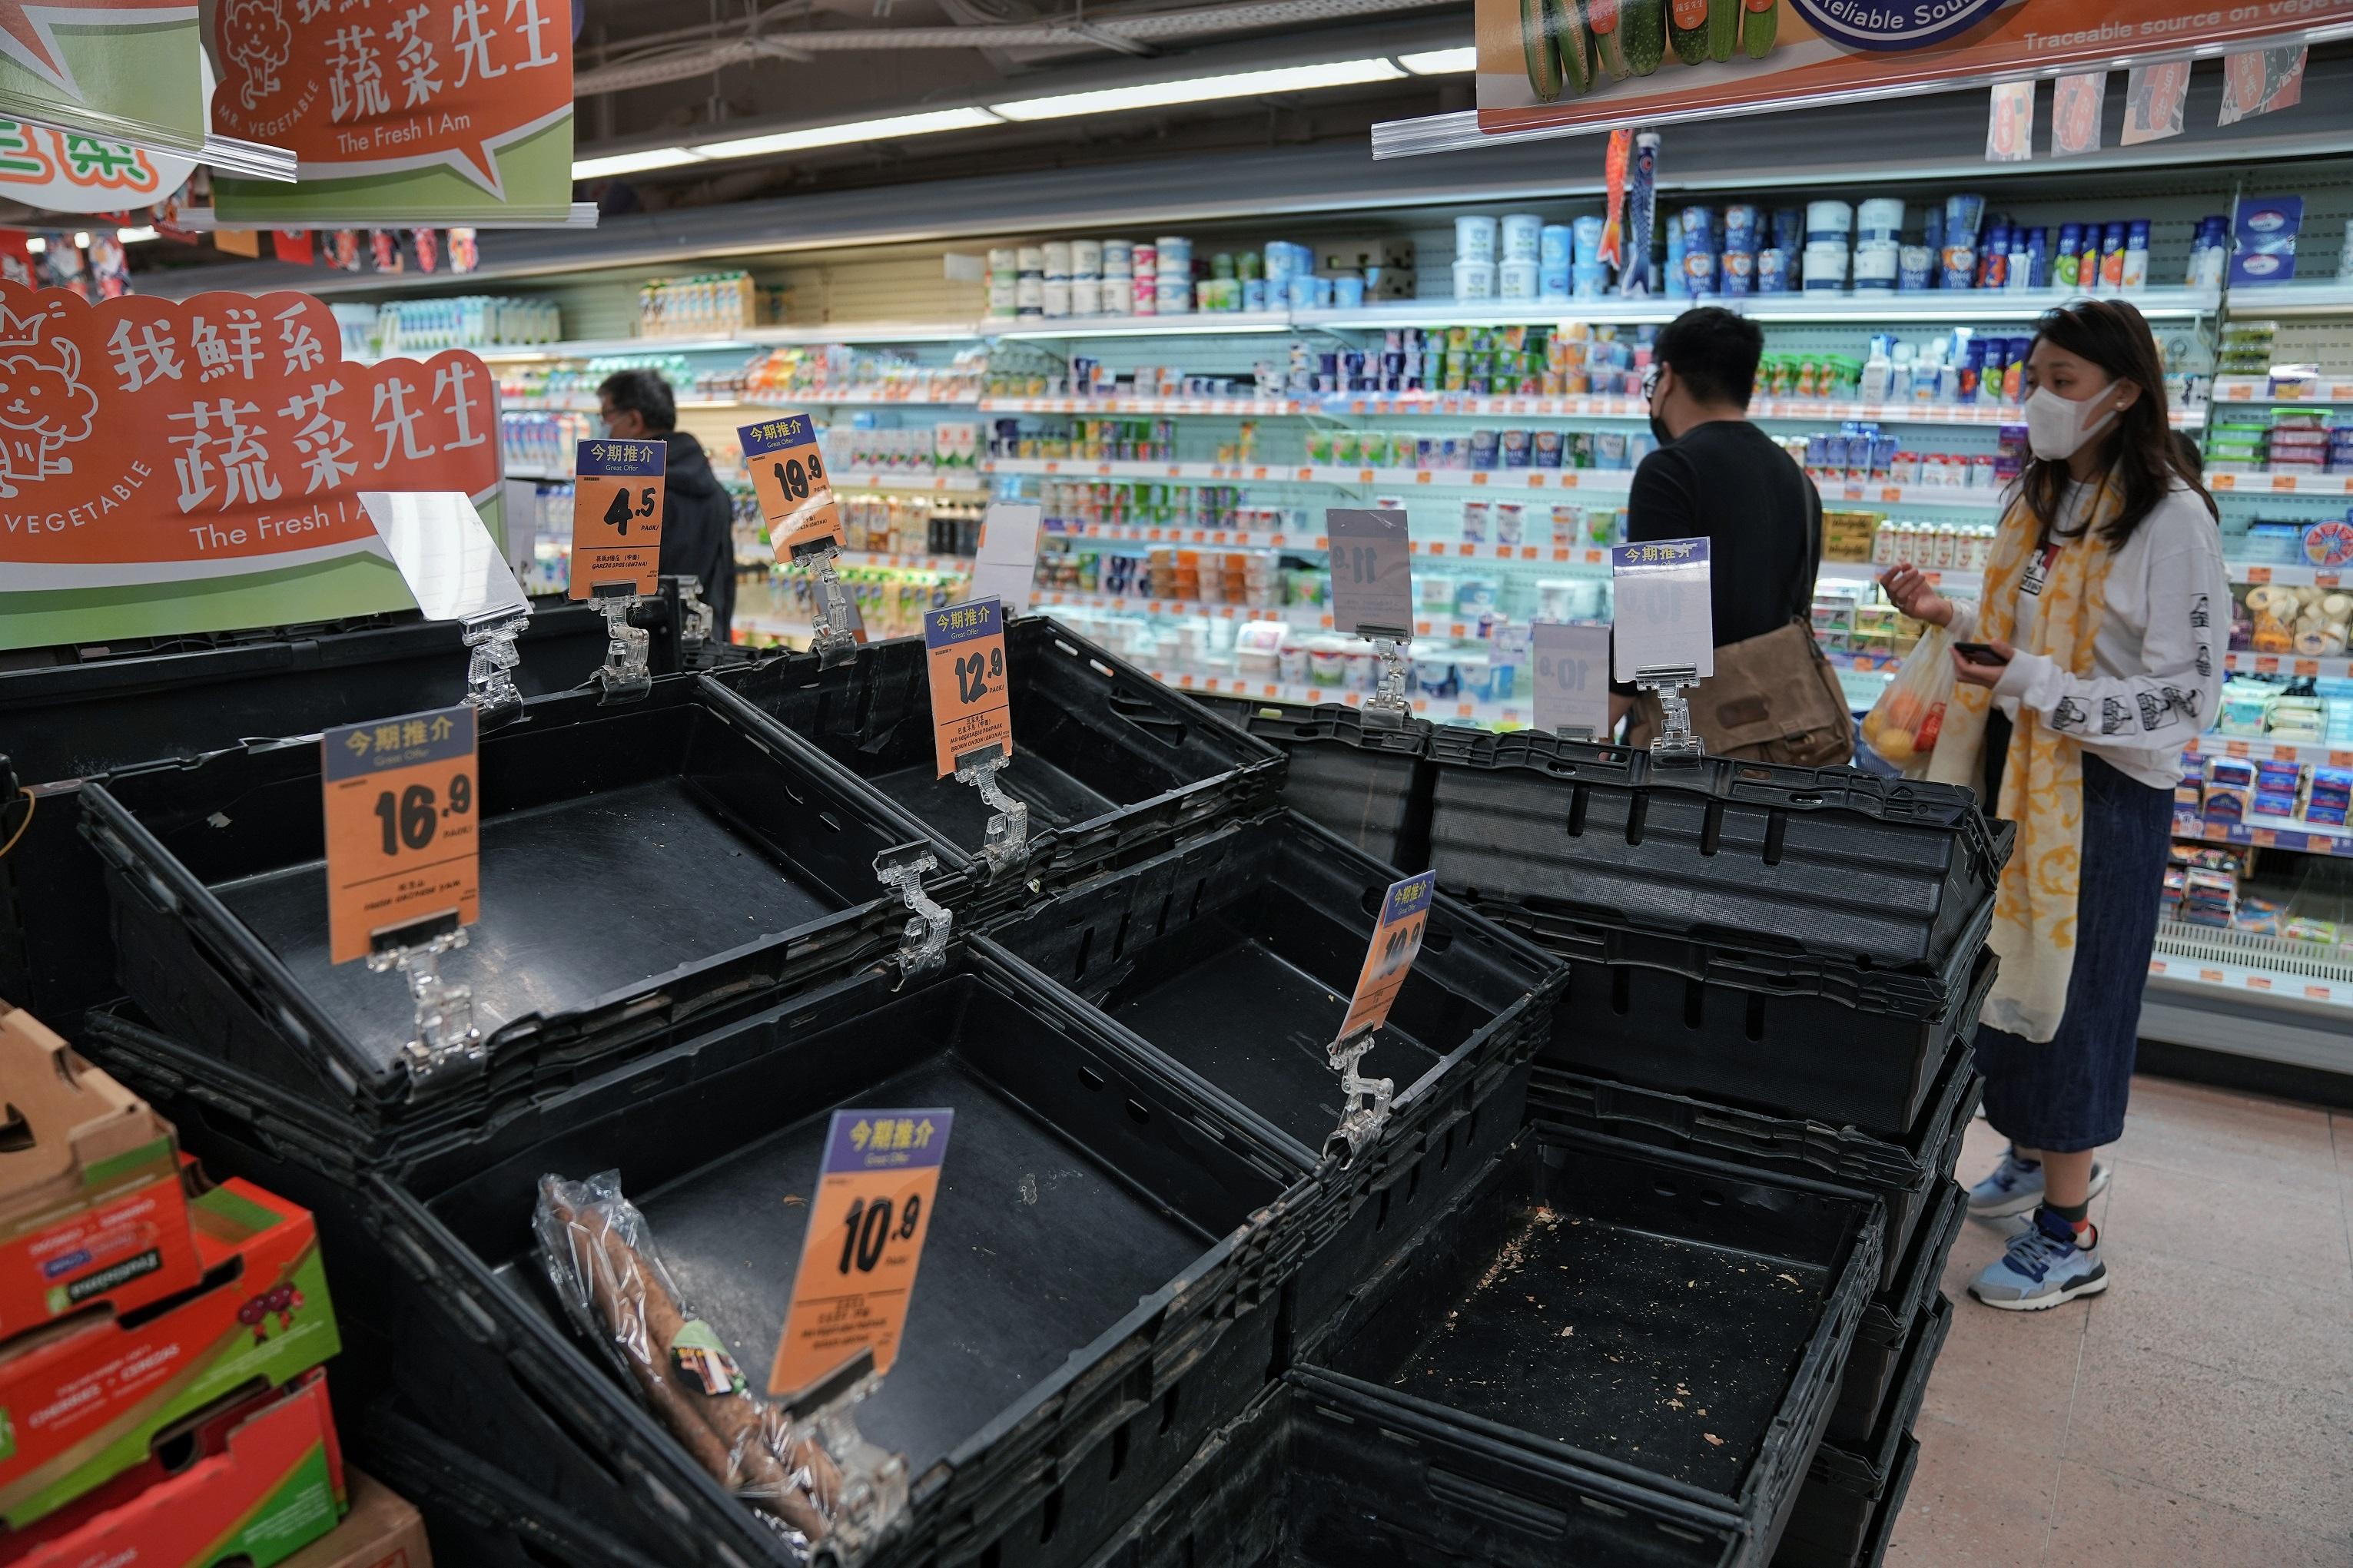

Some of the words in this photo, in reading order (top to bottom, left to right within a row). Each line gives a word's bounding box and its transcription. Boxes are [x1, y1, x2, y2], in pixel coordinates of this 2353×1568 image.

[2024, 21, 2132, 51] Traceable
[2140, 11, 2221, 35] source
[2229, 5, 2258, 22] on
[248, 80, 320, 138] VEGETABLE
[337, 134, 369, 154] The
[374, 118, 423, 148] Fresh
[428, 117, 433, 136] I
[439, 112, 471, 134] Am
[107, 300, 326, 393] 我鮮系
[166, 361, 487, 514] 蔬菜先生
[590, 443, 654, 462] 今期推介
[749, 419, 801, 443] 今期推介
[5, 459, 152, 534] VEGETABLE
[774, 454, 822, 502] 19.9
[189, 525, 247, 551] The
[257, 504, 330, 539] Fresh
[339, 502, 345, 523] I
[603, 487, 656, 536] 4.5
[592, 562, 612, 570] GARLIC
[936, 606, 991, 632] 今期推介
[966, 628, 979, 637] Offer
[955, 648, 1003, 704] 12.9
[346, 715, 453, 757] 今期推介
[951, 742, 967, 753] BROWN
[967, 737, 984, 748] ONION
[374, 773, 471, 857] 16.9
[1395, 880, 1427, 907] 今期推介
[850, 1119, 934, 1152] 今期推介
[838, 1194, 921, 1277] 10.9
